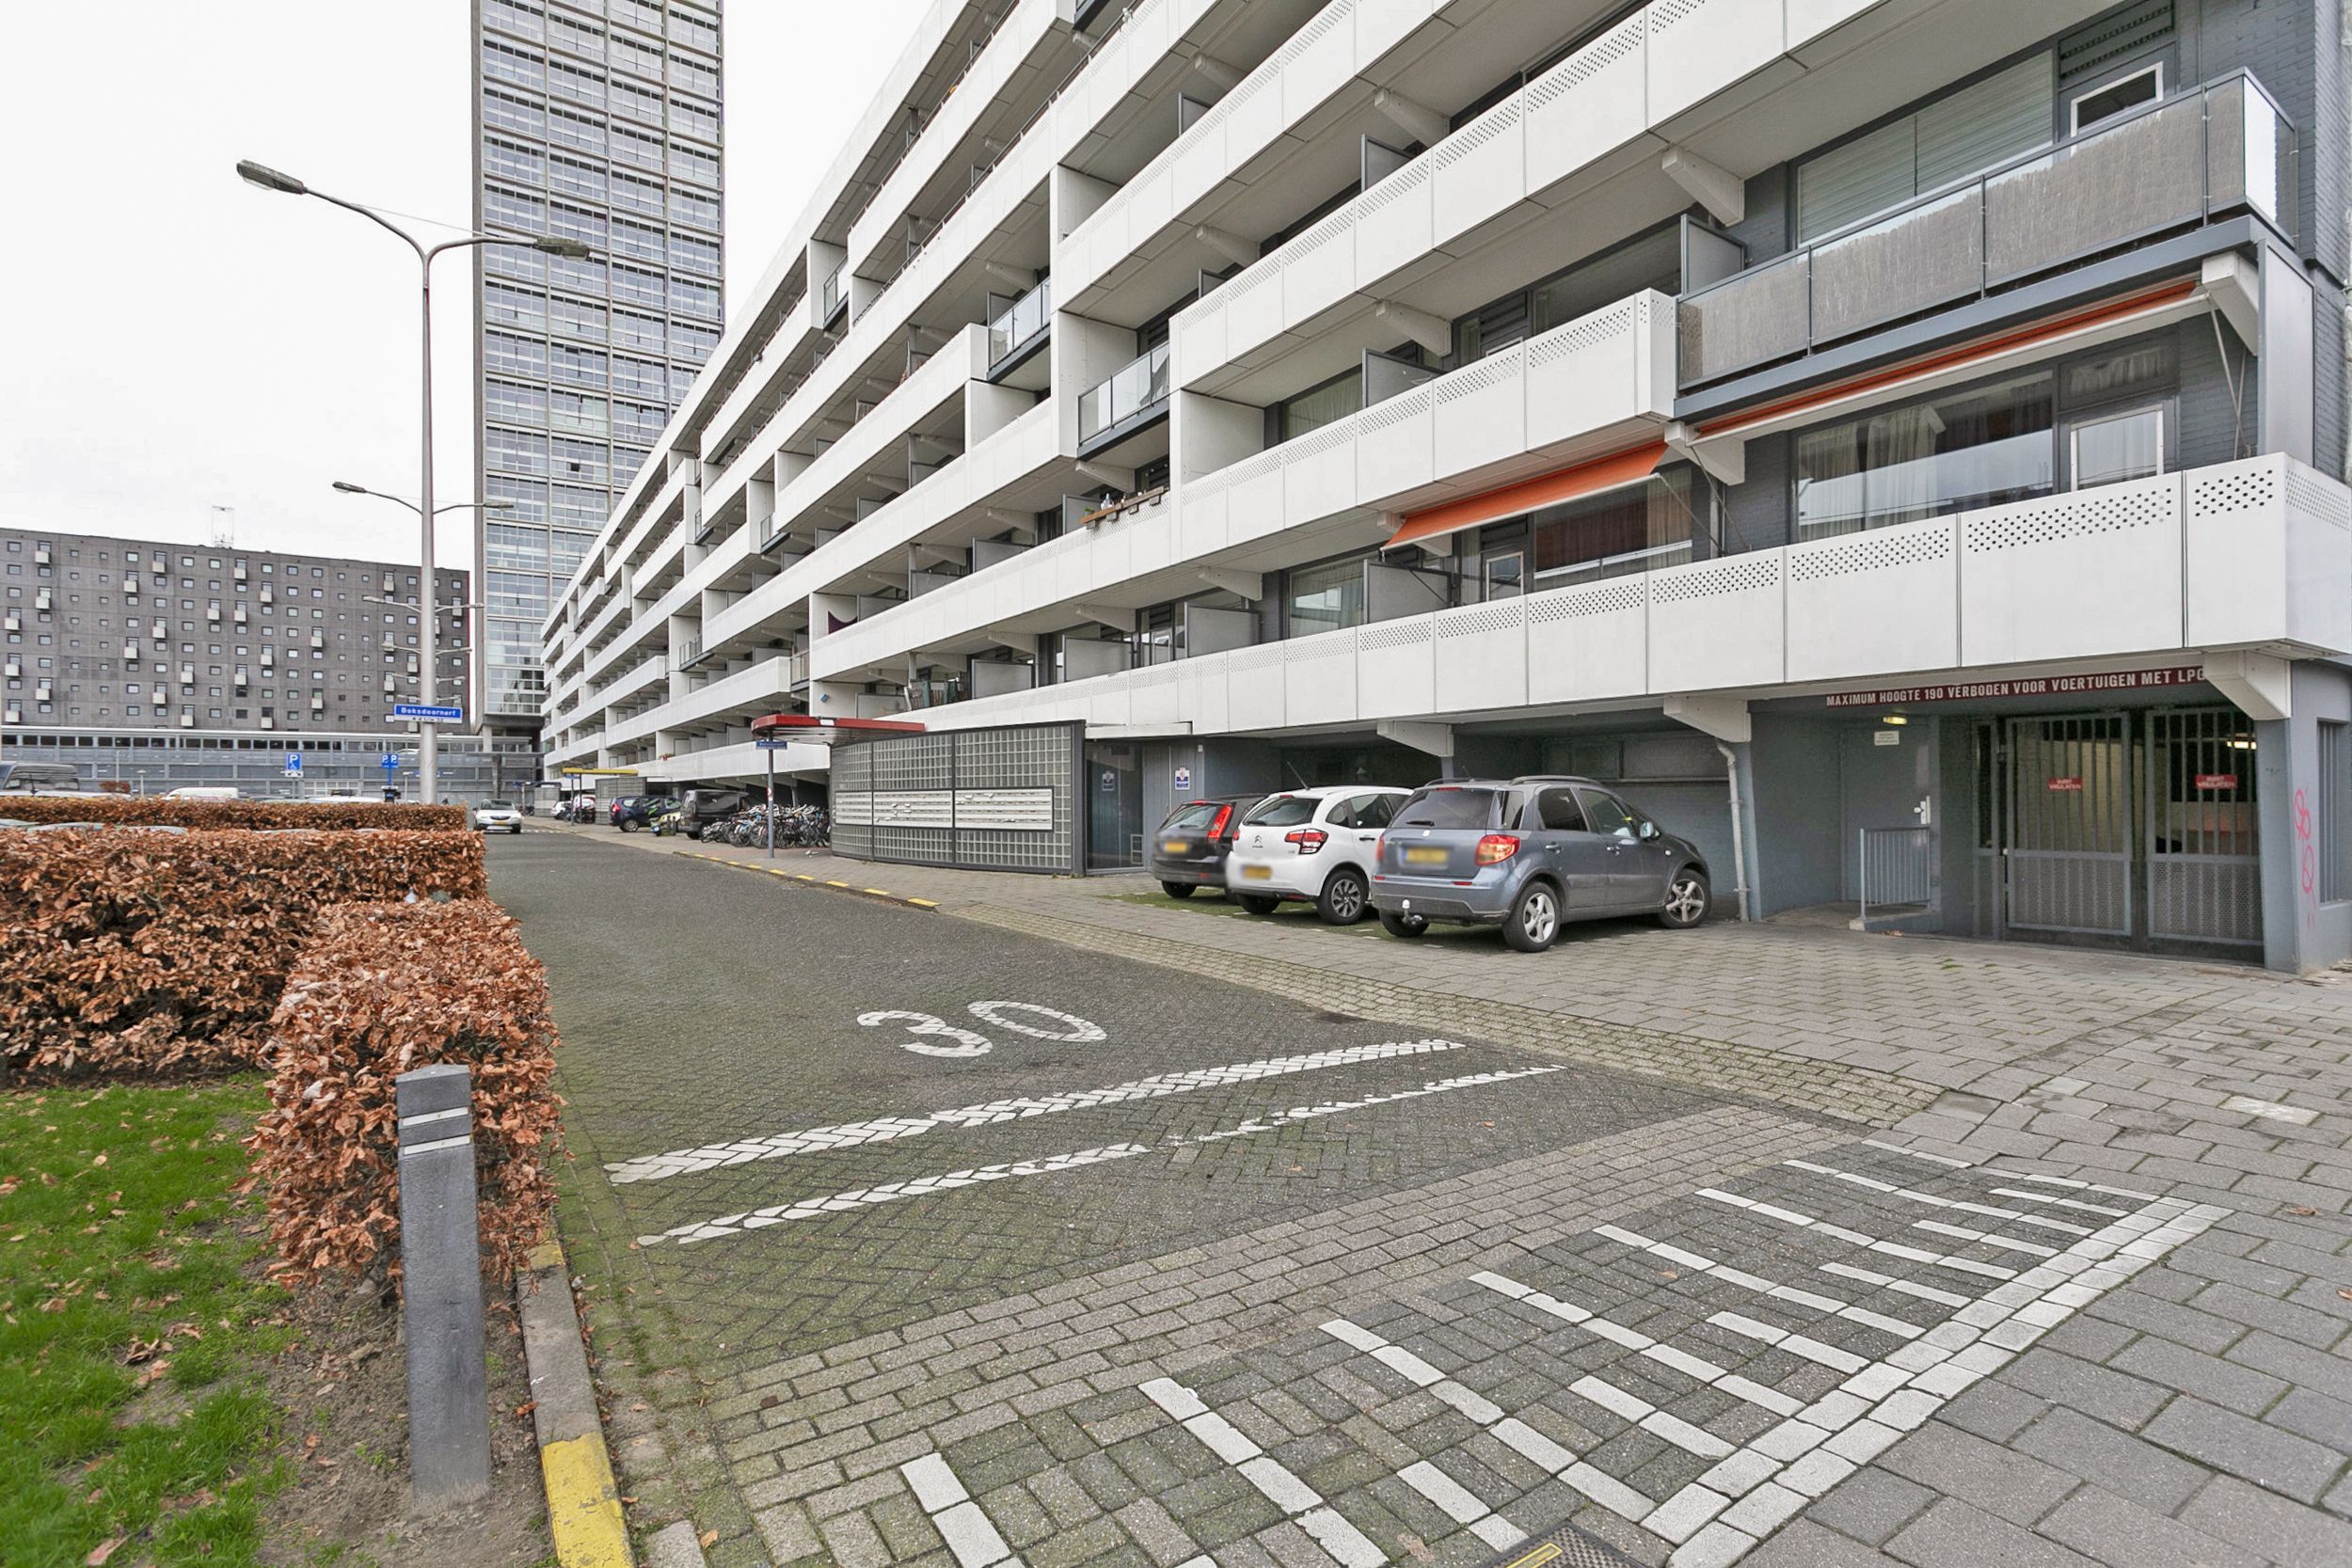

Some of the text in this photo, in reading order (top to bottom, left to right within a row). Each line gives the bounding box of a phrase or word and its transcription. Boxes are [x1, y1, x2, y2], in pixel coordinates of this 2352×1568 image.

[1826, 693, 1876, 706] MAXIMUM
[1880, 689, 1920, 703] HOOGTE
[1925, 687, 1944, 700] 190
[1947, 683, 2009, 699] VERBODEN
[2013, 679, 2046, 694] VOOR
[2052, 673, 2136, 690] VOERTUIGEN
[2141, 671, 2171, 685] MET
[856, 1001, 1107, 1057] 30
